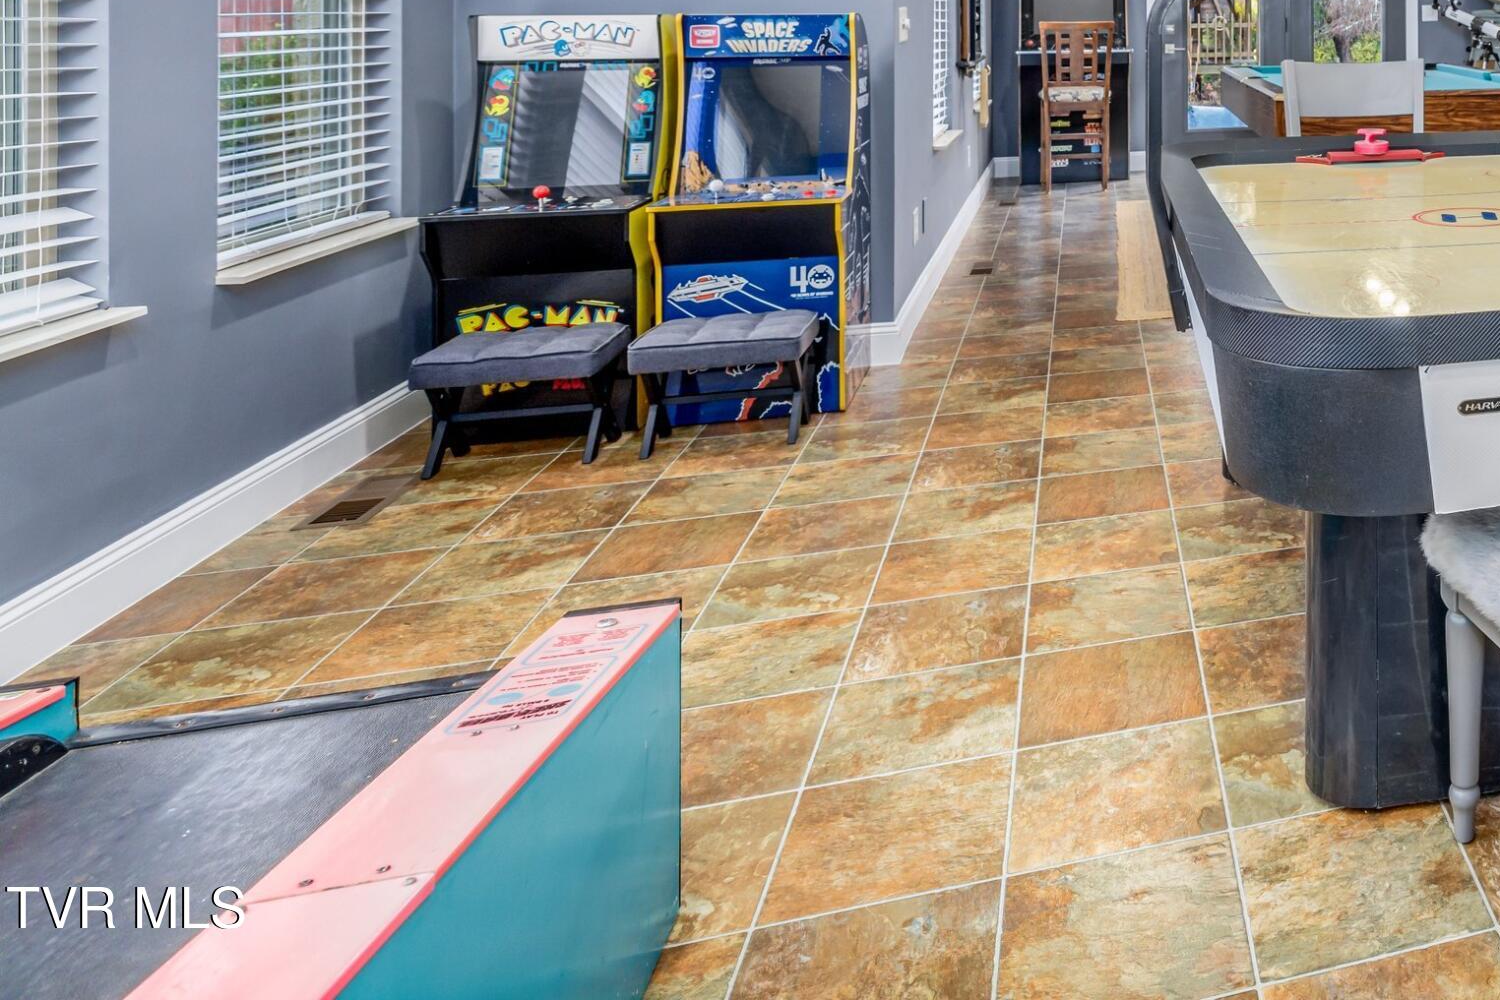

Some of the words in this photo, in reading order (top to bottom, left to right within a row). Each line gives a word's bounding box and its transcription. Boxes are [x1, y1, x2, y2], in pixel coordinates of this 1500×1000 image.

[499, 20, 637, 48] PAC-MAN
[741, 20, 800, 39] SPACE
[725, 38, 813, 54] INVADERS
[456, 303, 619, 335] PAC-MAN
